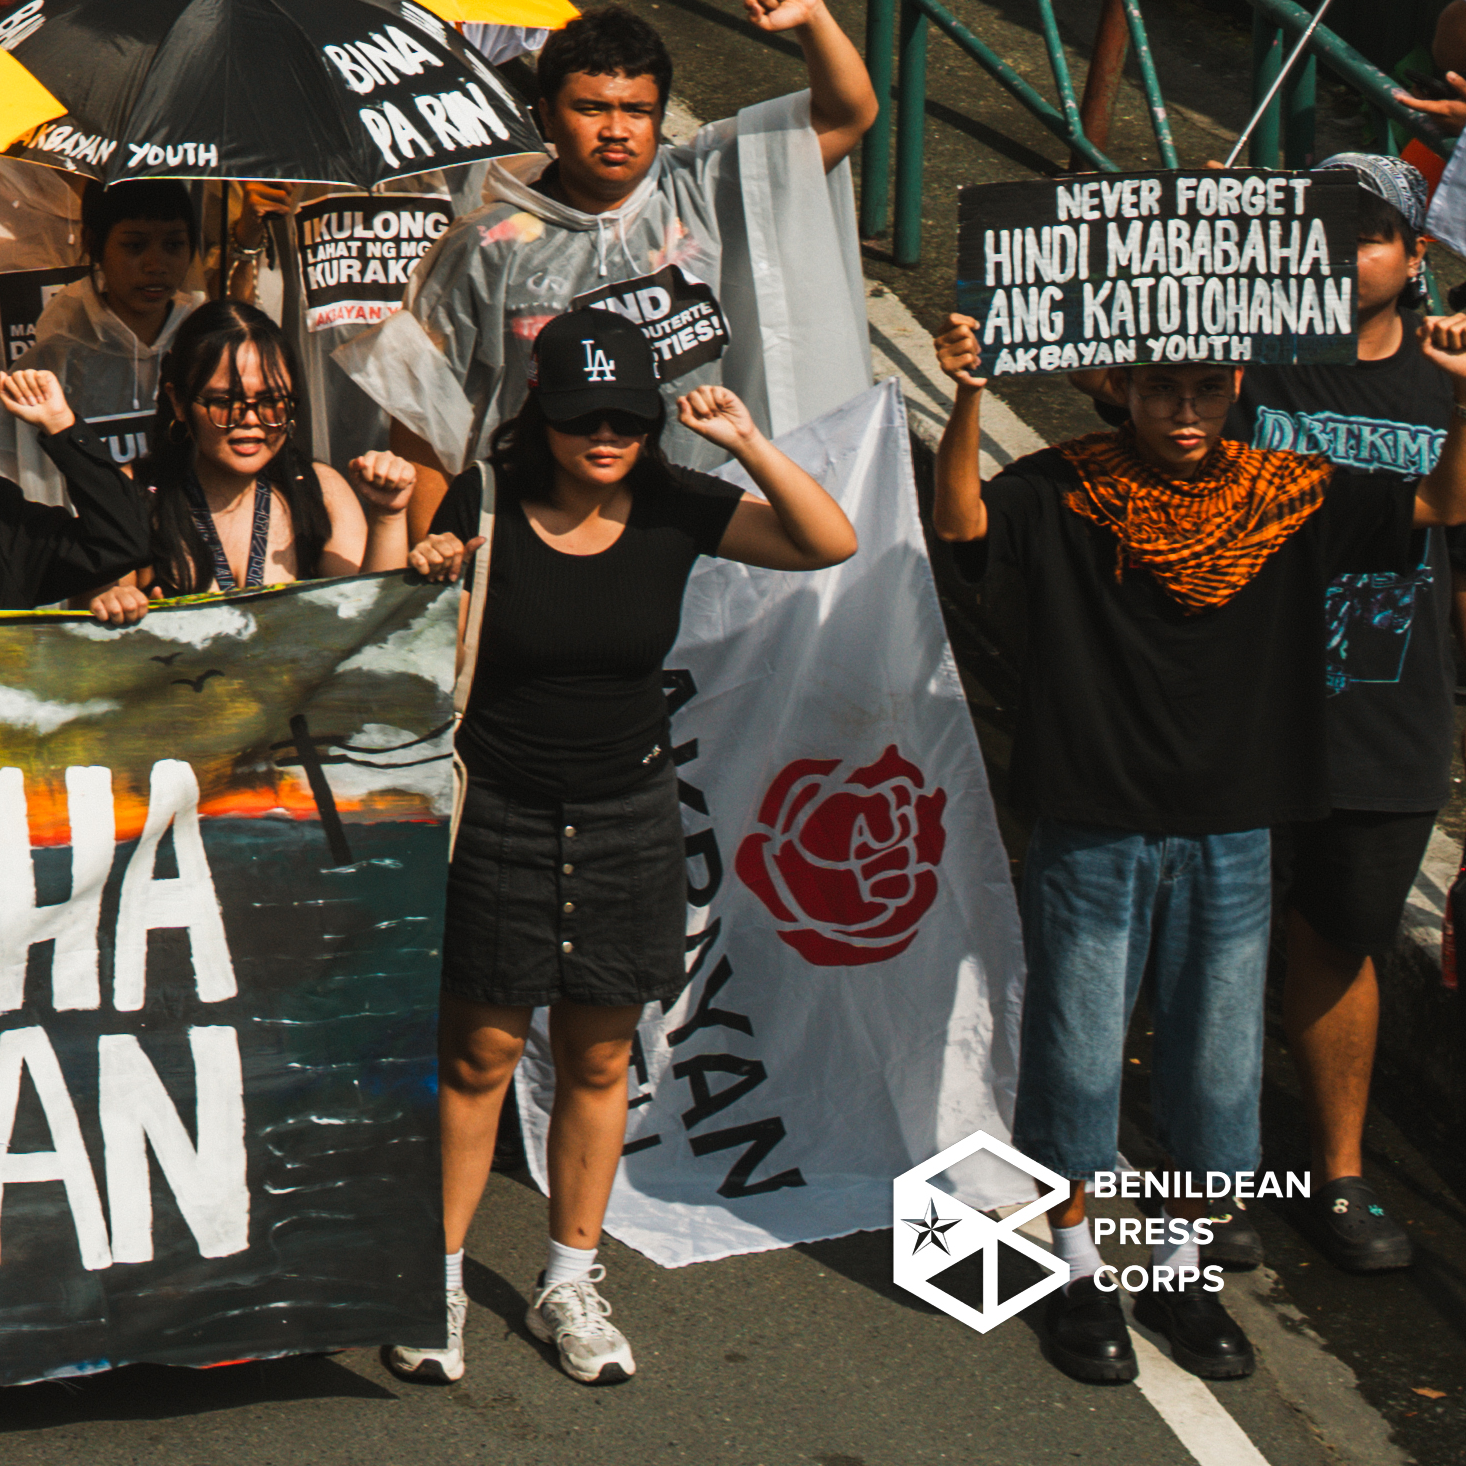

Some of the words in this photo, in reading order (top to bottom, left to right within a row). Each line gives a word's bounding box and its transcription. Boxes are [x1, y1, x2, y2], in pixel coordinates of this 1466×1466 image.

[323, 23, 445, 97] BINA
[127, 141, 218, 169] YOUTH
[358, 104, 436, 170] PA
[1056, 178, 1163, 222] NEVER
[1175, 176, 1313, 219] FORGET
[302, 211, 451, 247] IKULONG
[306, 240, 363, 266] LAHAT
[366, 241, 398, 261] NG
[983, 224, 1090, 288] HINDI
[1106, 218, 1332, 278] MABABAHA
[982, 284, 1065, 346] ANG
[1082, 275, 1352, 340] KATOTOHANAN
[581, 339, 617, 383] LA
[993, 340, 1138, 377] AKBAYAN
[1145, 334, 1252, 362] YOUTH
